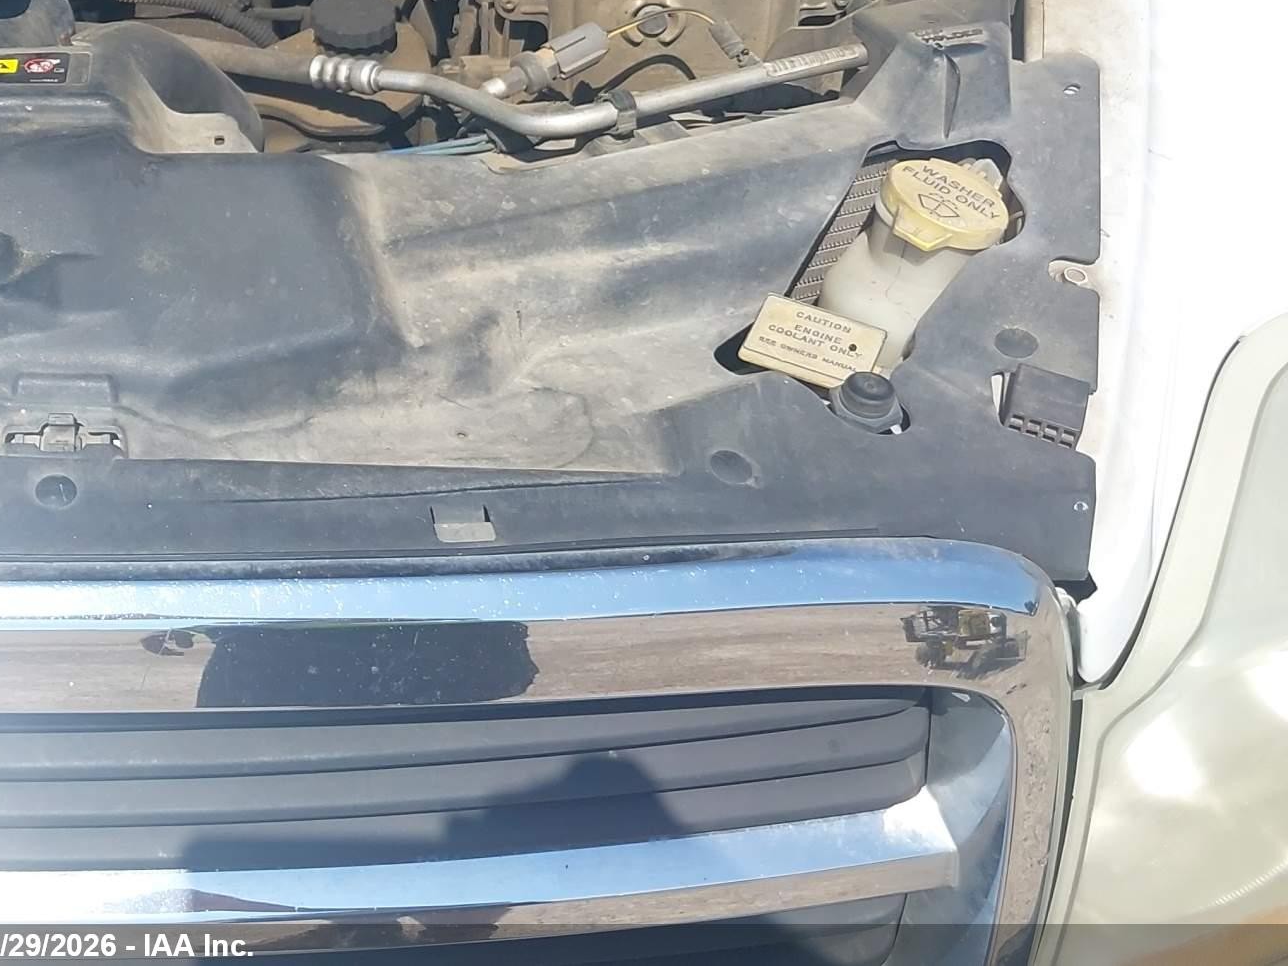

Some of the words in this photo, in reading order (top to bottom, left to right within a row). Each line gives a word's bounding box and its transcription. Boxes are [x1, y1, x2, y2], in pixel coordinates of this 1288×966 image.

[902, 165, 952, 195] FLUID
[955, 194, 1000, 219] ONLY
[922, 165, 996, 209] WASHER
[794, 324, 843, 345] ENGINE
[795, 310, 853, 334] CAUTION
[768, 323, 826, 347] COOLANT
[829, 344, 863, 360] ONLY
